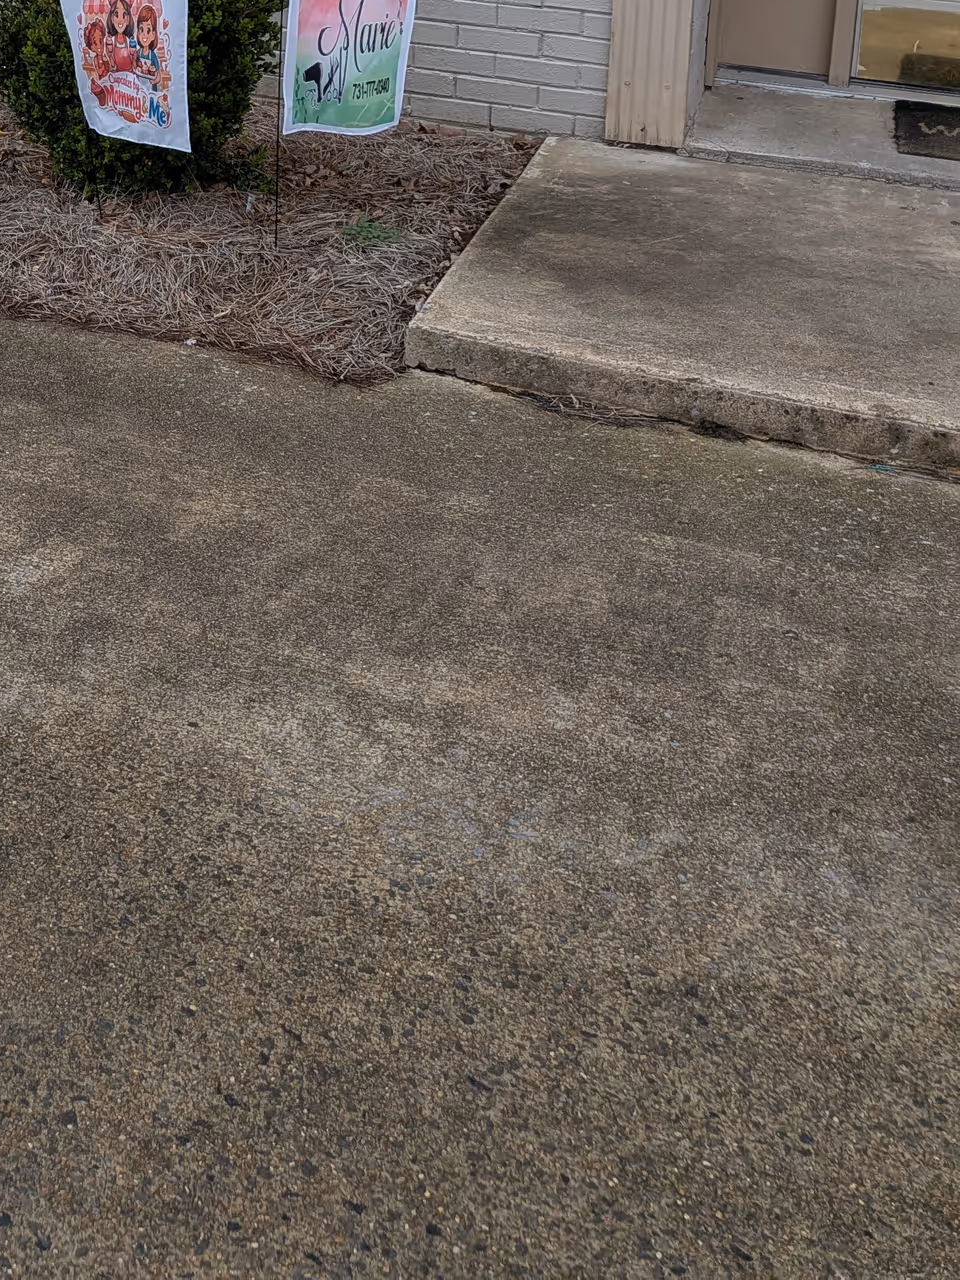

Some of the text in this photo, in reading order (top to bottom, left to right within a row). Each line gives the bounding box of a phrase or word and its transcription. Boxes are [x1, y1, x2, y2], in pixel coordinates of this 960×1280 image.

[108, 73, 140, 95] Cupcakes by
[103, 85, 167, 127] Mommy & Me
